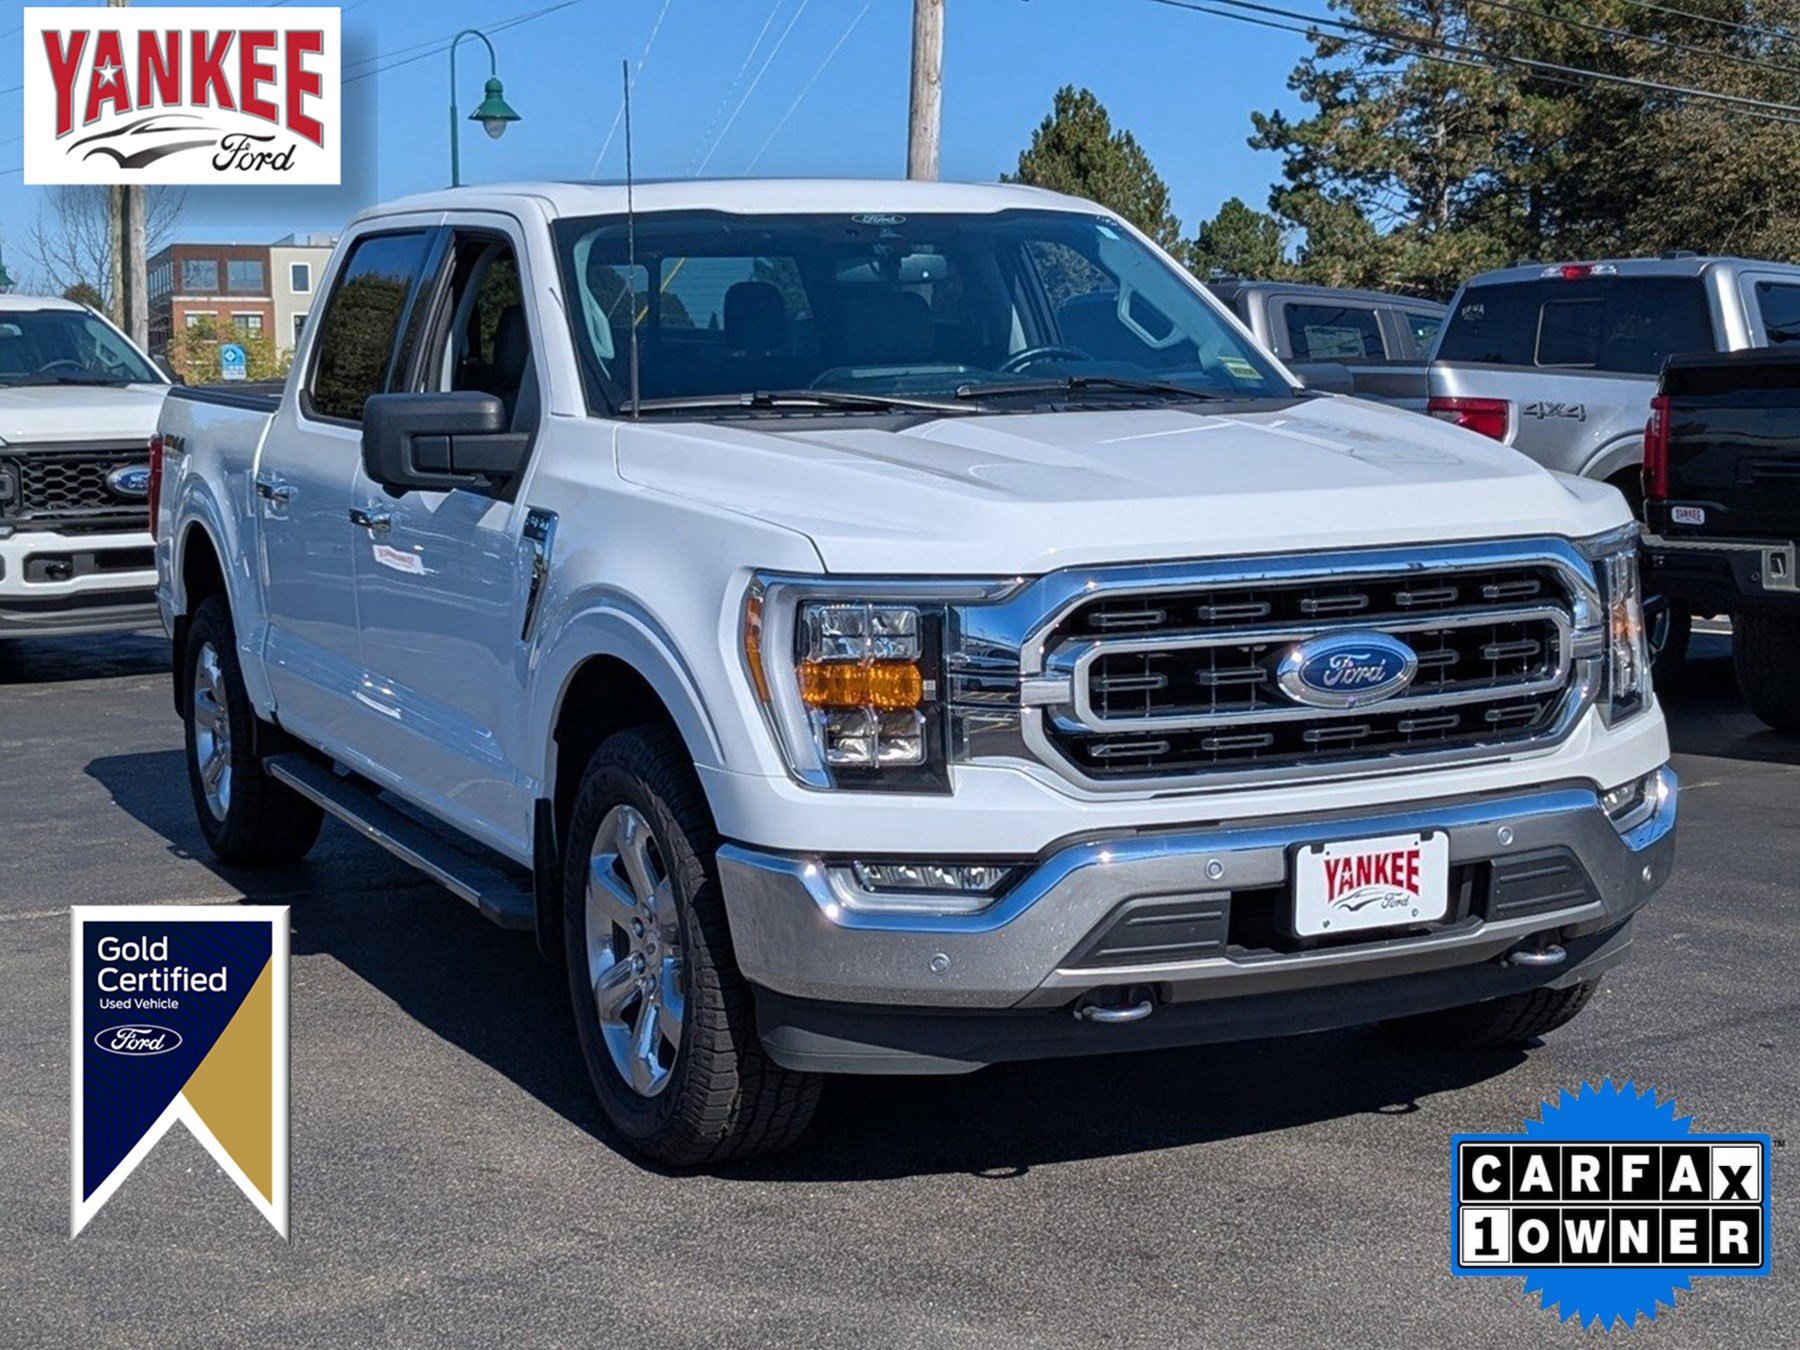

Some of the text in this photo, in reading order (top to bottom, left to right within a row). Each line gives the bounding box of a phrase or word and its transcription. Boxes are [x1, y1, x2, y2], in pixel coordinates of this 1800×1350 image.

[1323, 653, 1386, 686] Ford
[1324, 850, 1420, 903] YANKEE
[1381, 892, 1410, 909] Ford
